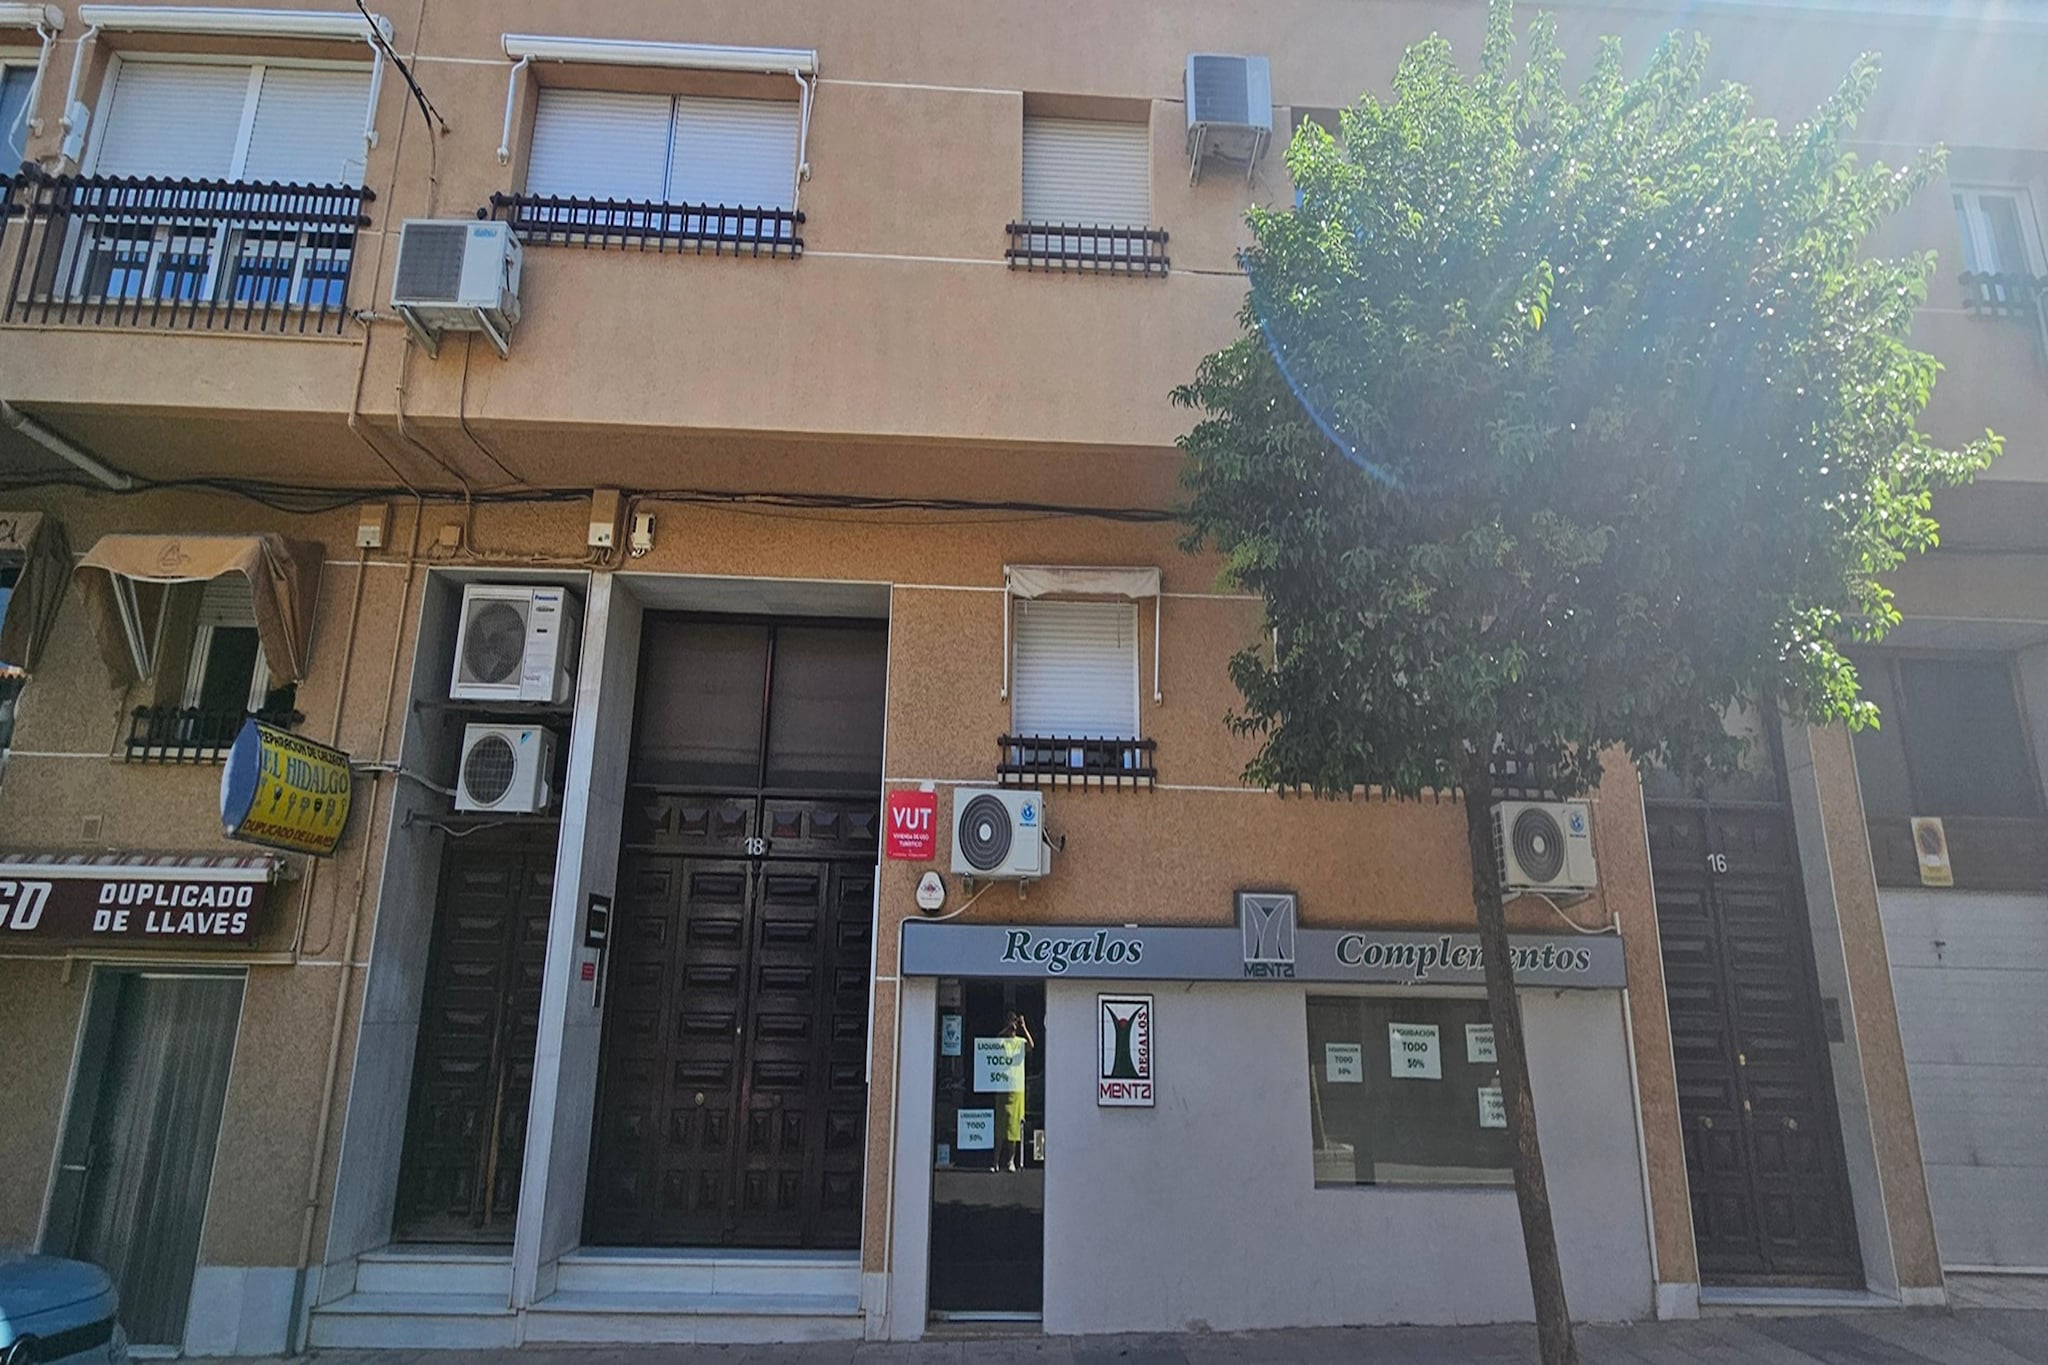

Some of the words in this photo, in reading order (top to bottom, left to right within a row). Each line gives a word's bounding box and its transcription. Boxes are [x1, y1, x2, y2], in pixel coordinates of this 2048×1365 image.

[286, 757, 349, 795] HIDALGO
[893, 806, 932, 830] VUT
[744, 837, 763, 855] 18
[1707, 853, 1727, 872] 16
[99, 883, 254, 908] DUPLICADO
[93, 909, 130, 931] DE
[145, 911, 248, 934] LLAVES
[1000, 929, 1144, 974] Regalos
[1138, 1012, 1147, 1074] REGALOS
[1402, 1041, 1428, 1052] TODO
[1335, 1055, 1353, 1064] TODO
[1407, 1058, 1425, 1069] 50%
[990, 1072, 1009, 1083] 50%
[966, 1121, 986, 1130] TODO
